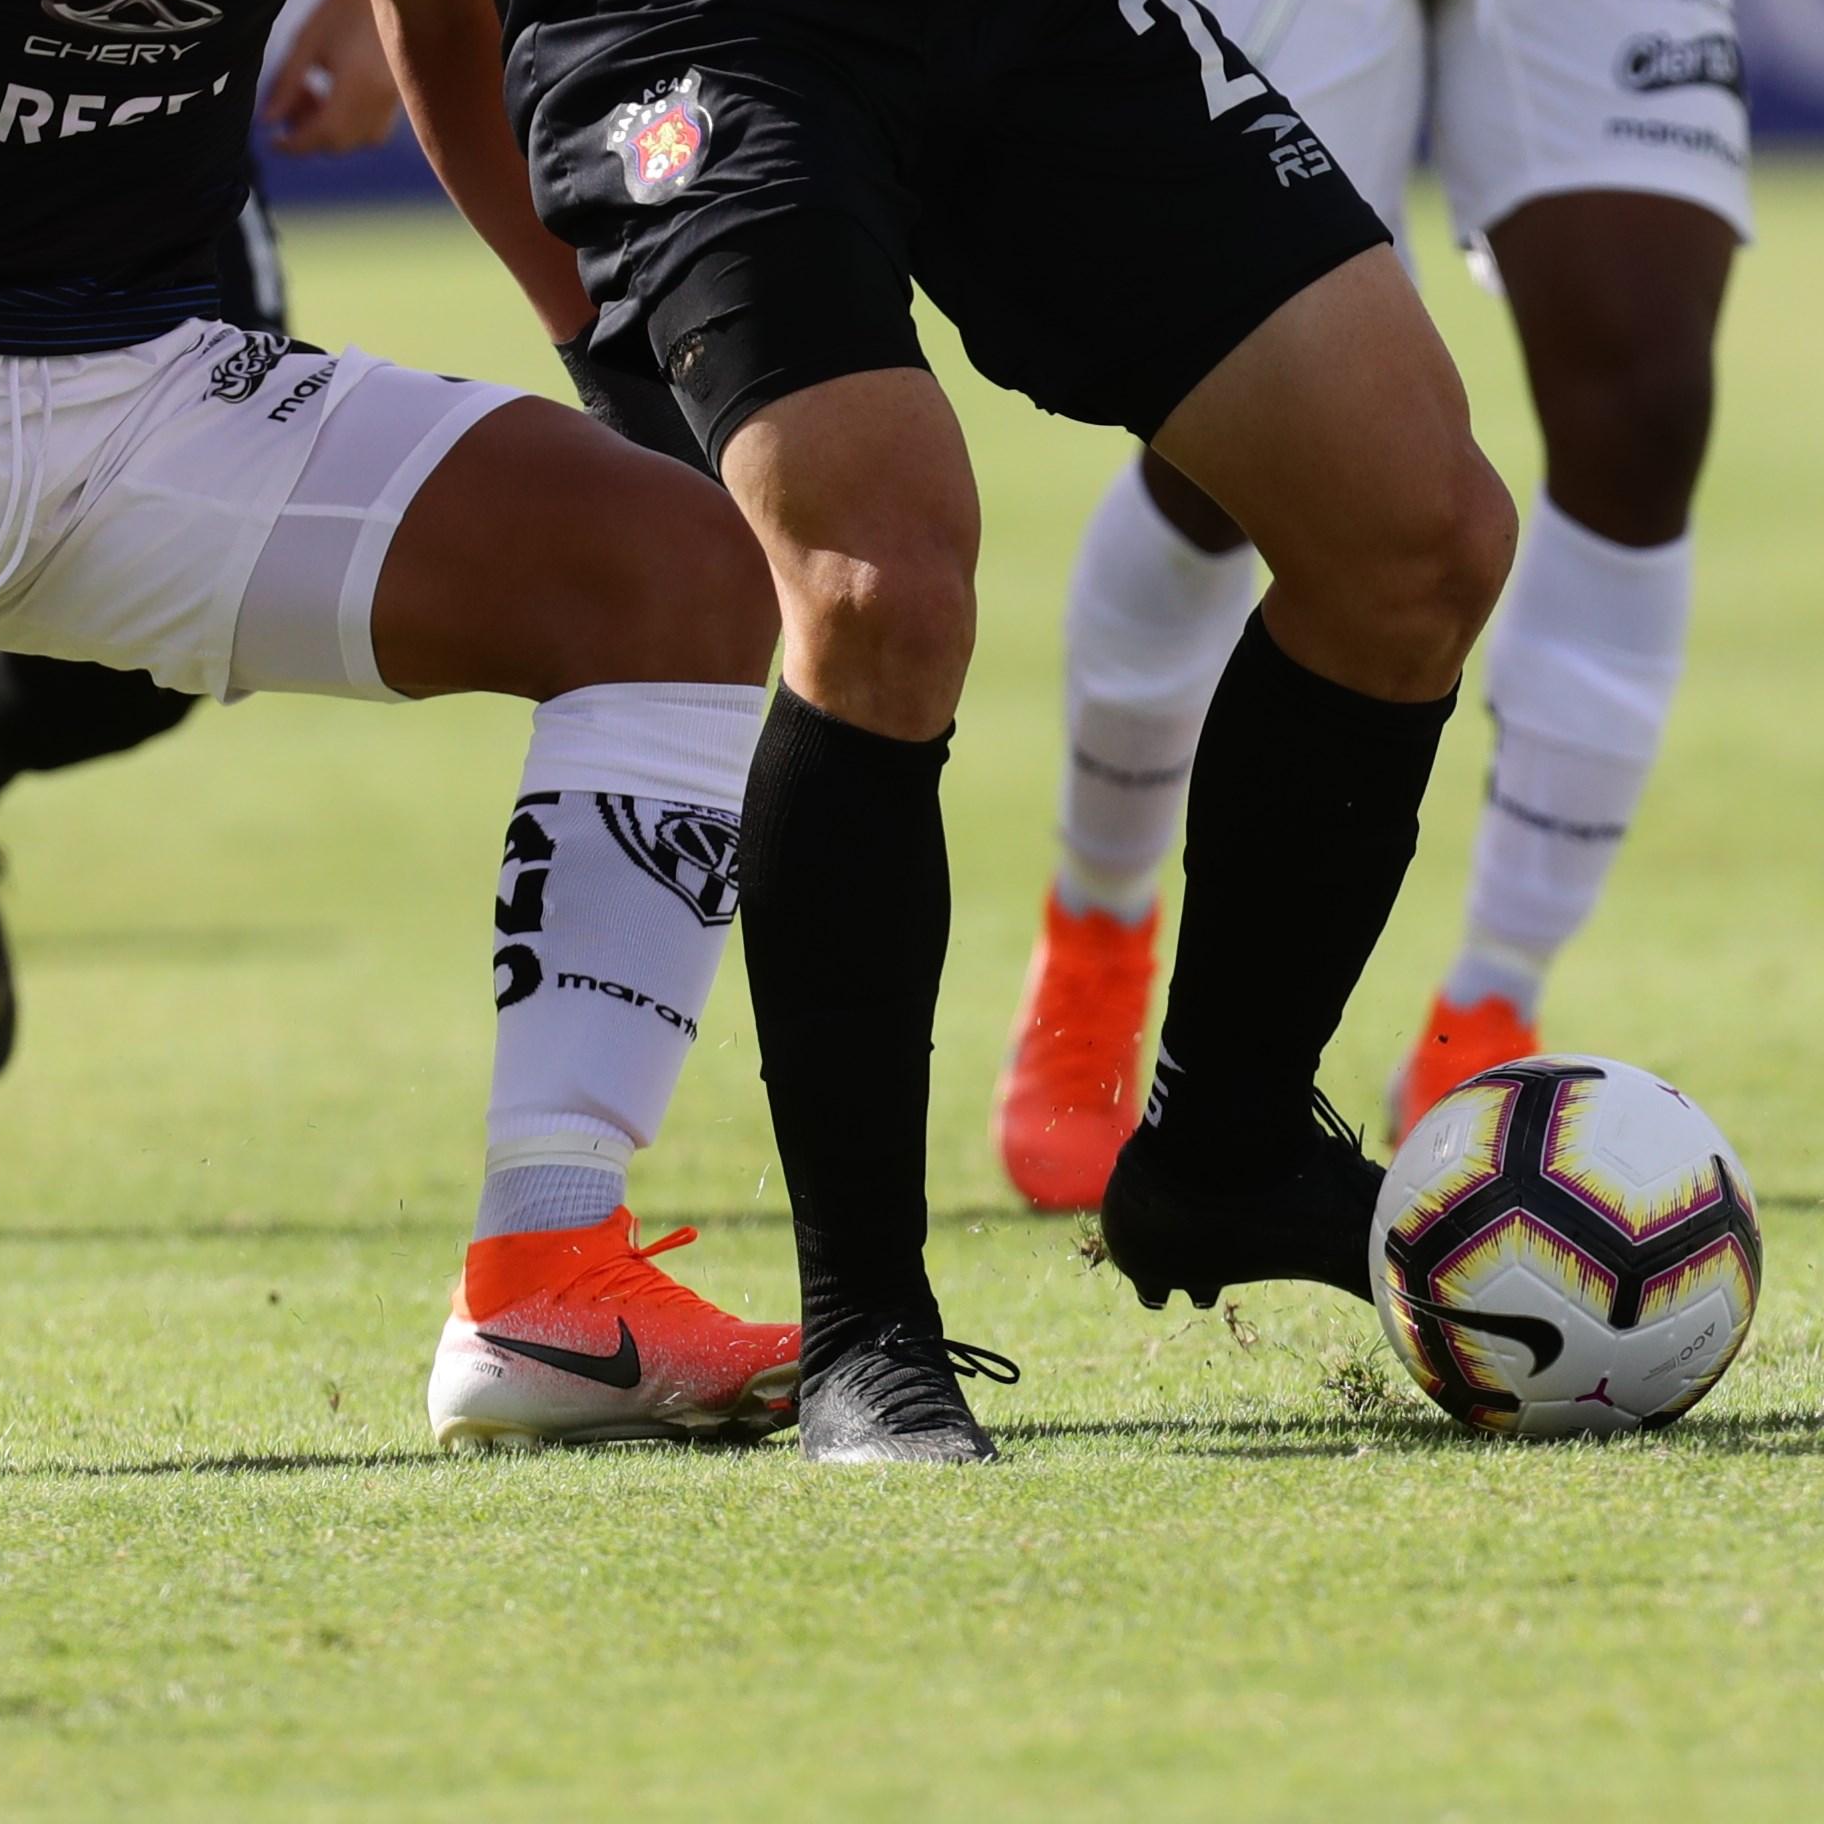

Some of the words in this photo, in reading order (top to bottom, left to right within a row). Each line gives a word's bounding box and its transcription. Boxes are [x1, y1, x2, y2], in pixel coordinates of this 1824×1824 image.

[24, 35, 200, 65] CHERY
[612, 77, 693, 143] CARACAS
[1268, 137, 1333, 188] RS
